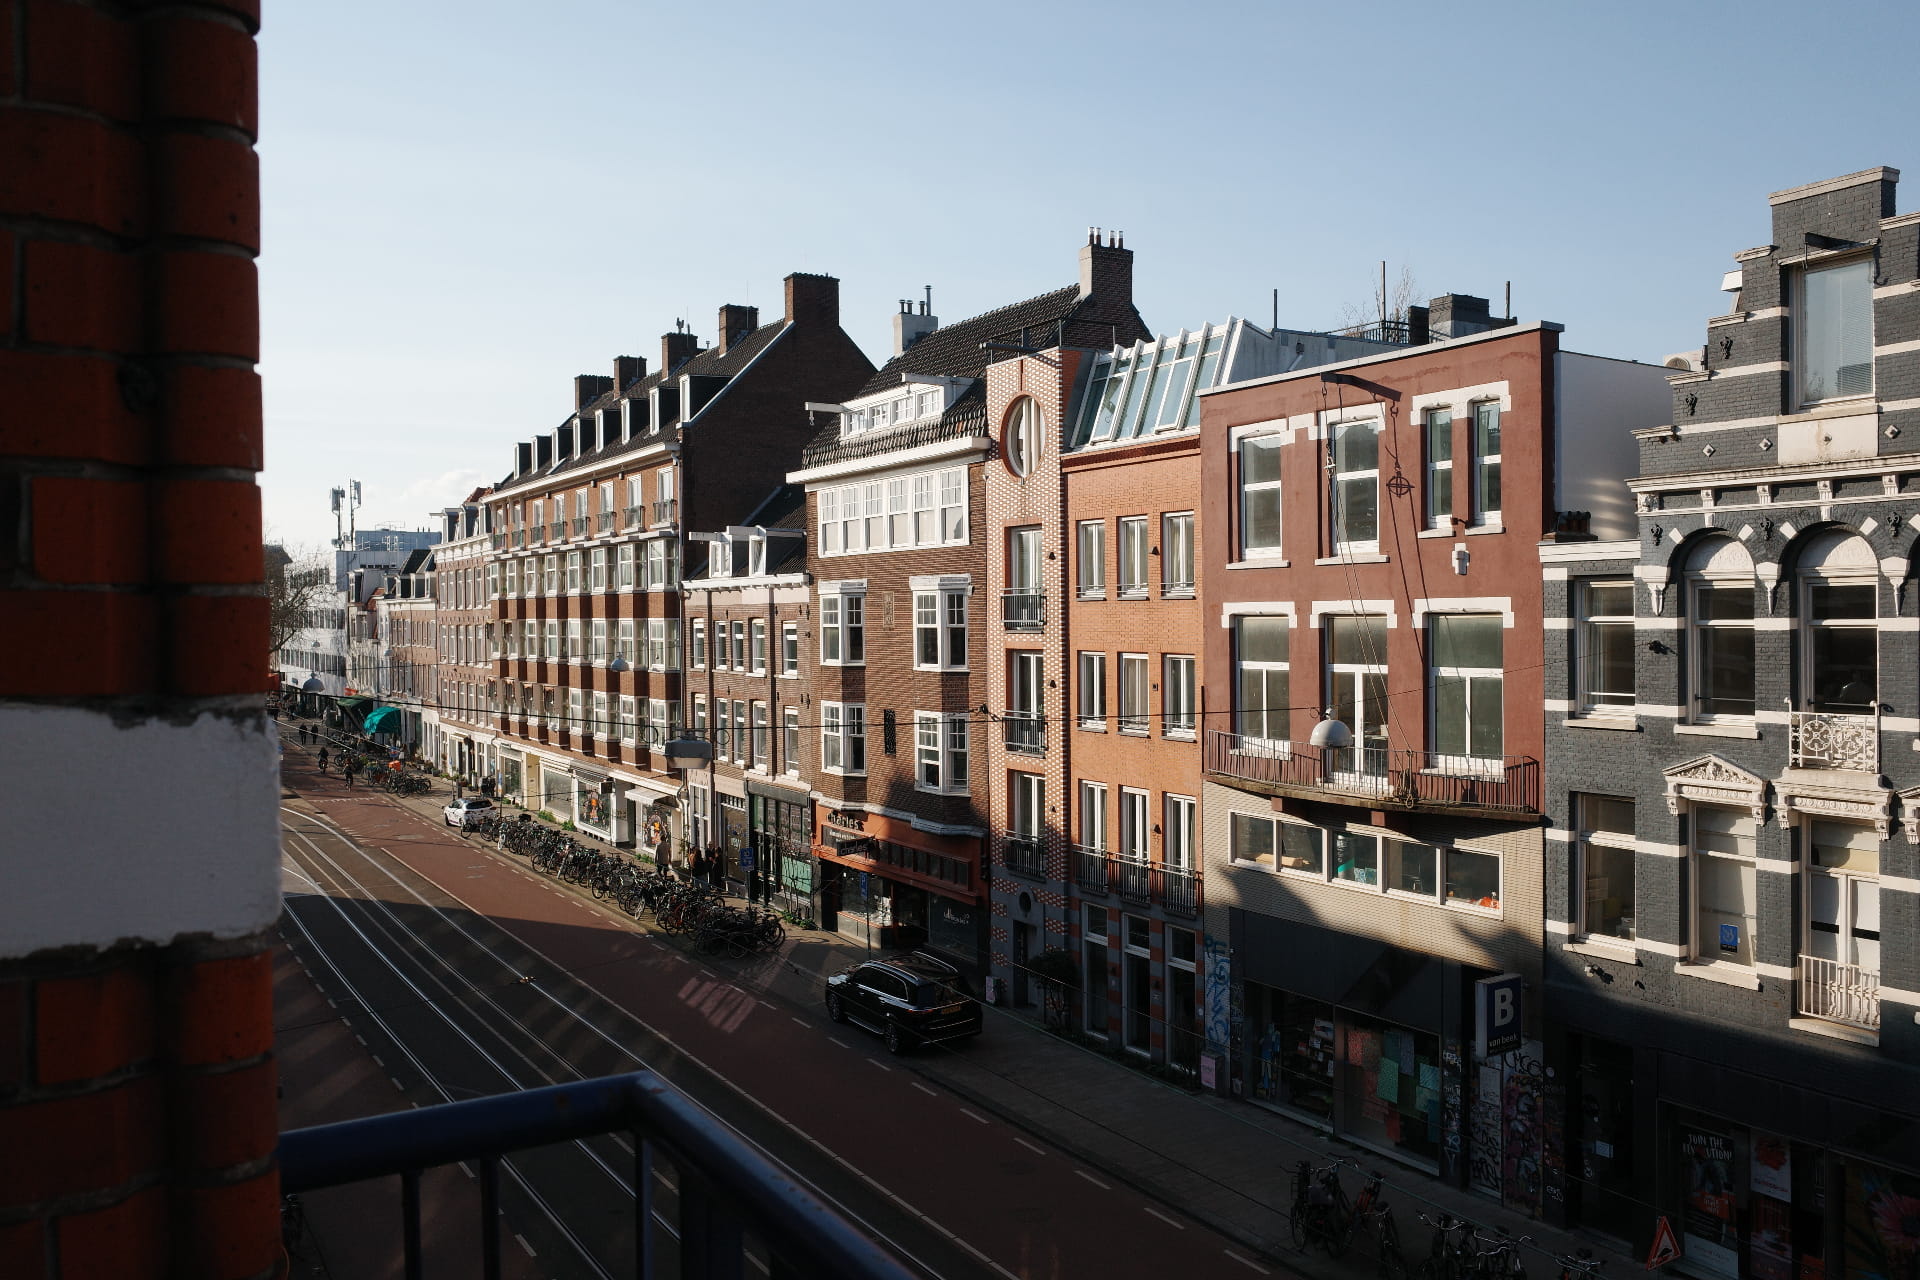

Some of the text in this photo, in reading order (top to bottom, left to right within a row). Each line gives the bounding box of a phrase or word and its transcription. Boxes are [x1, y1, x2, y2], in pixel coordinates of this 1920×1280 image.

[1494, 987, 1514, 1028] B
[1488, 1032, 1519, 1048] van beek
[1687, 1134, 1724, 1149] JOIN THE
